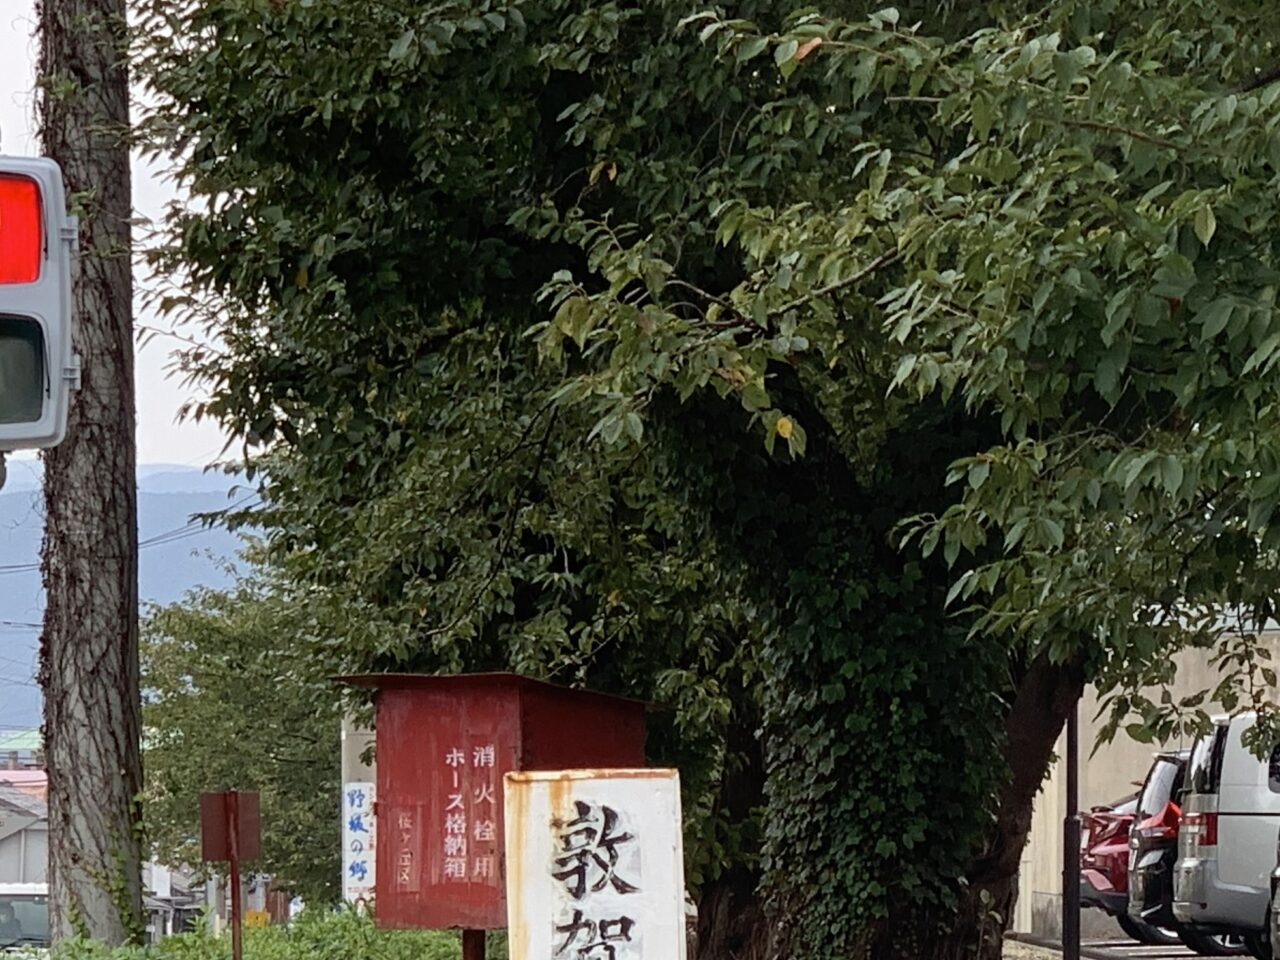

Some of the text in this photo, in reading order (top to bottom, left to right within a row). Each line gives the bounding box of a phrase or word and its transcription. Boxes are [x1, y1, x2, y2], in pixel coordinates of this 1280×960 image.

[444, 747, 467, 878] ホース格納箱
[472, 744, 496, 878] 消火栓用
